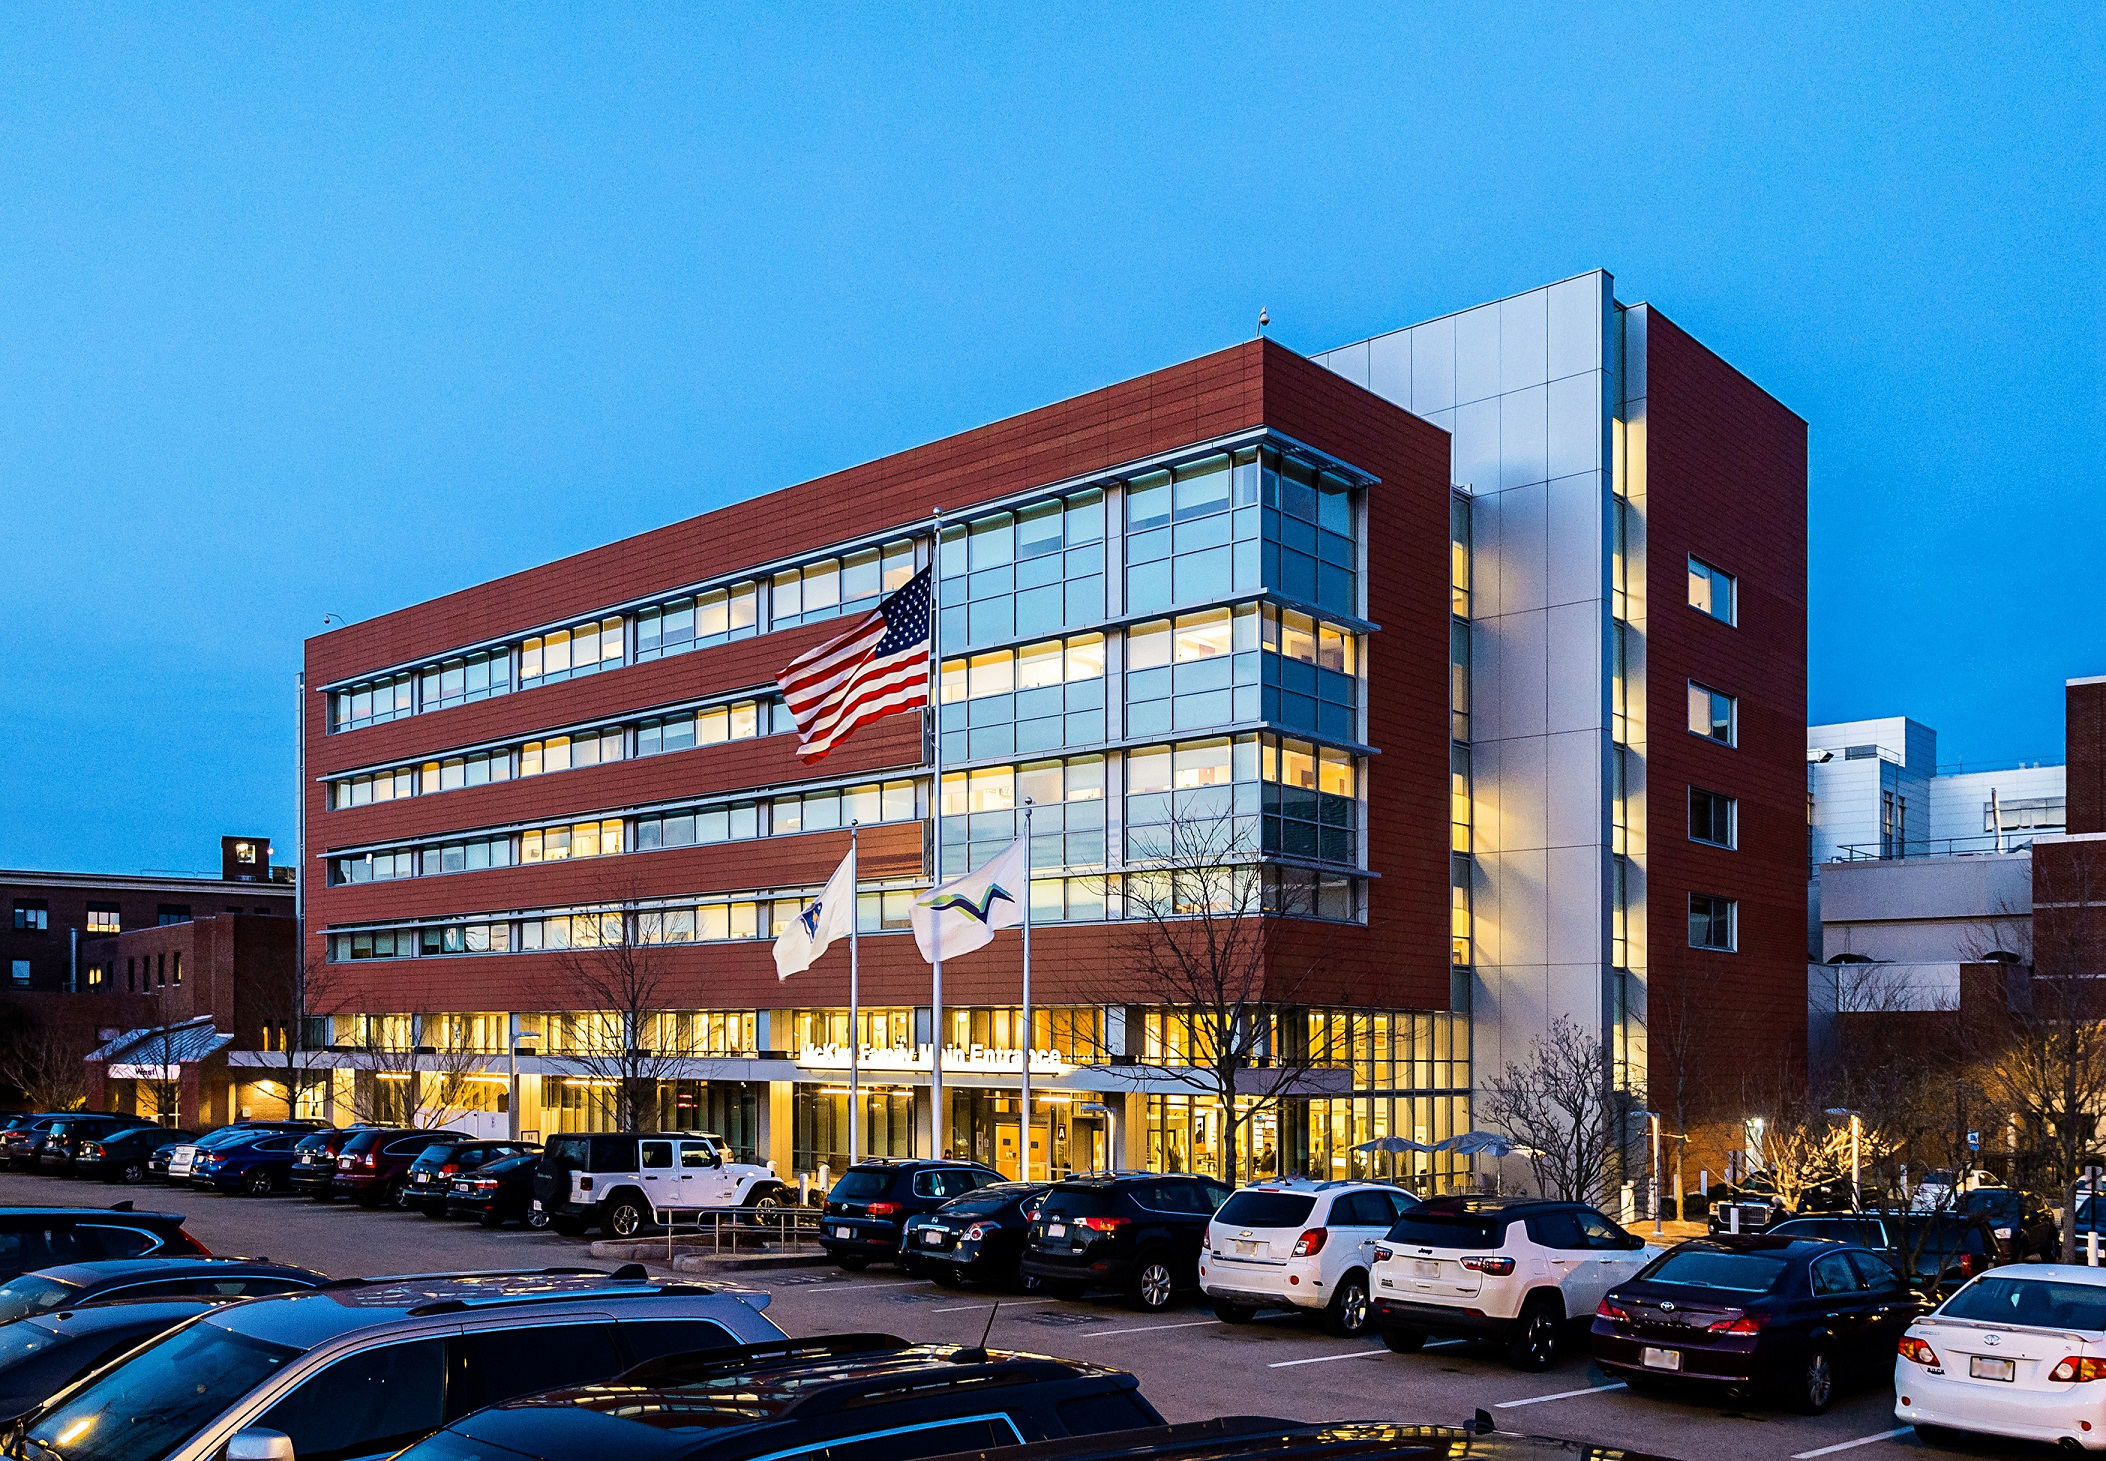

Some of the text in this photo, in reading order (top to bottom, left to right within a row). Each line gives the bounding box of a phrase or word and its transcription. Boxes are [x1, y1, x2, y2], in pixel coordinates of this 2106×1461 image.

[859, 1041, 914, 1064] Family
[970, 1044, 1062, 1064] Entrance
[1058, 1127, 1065, 1139] A
[1644, 1320, 1691, 1330] AVALON
